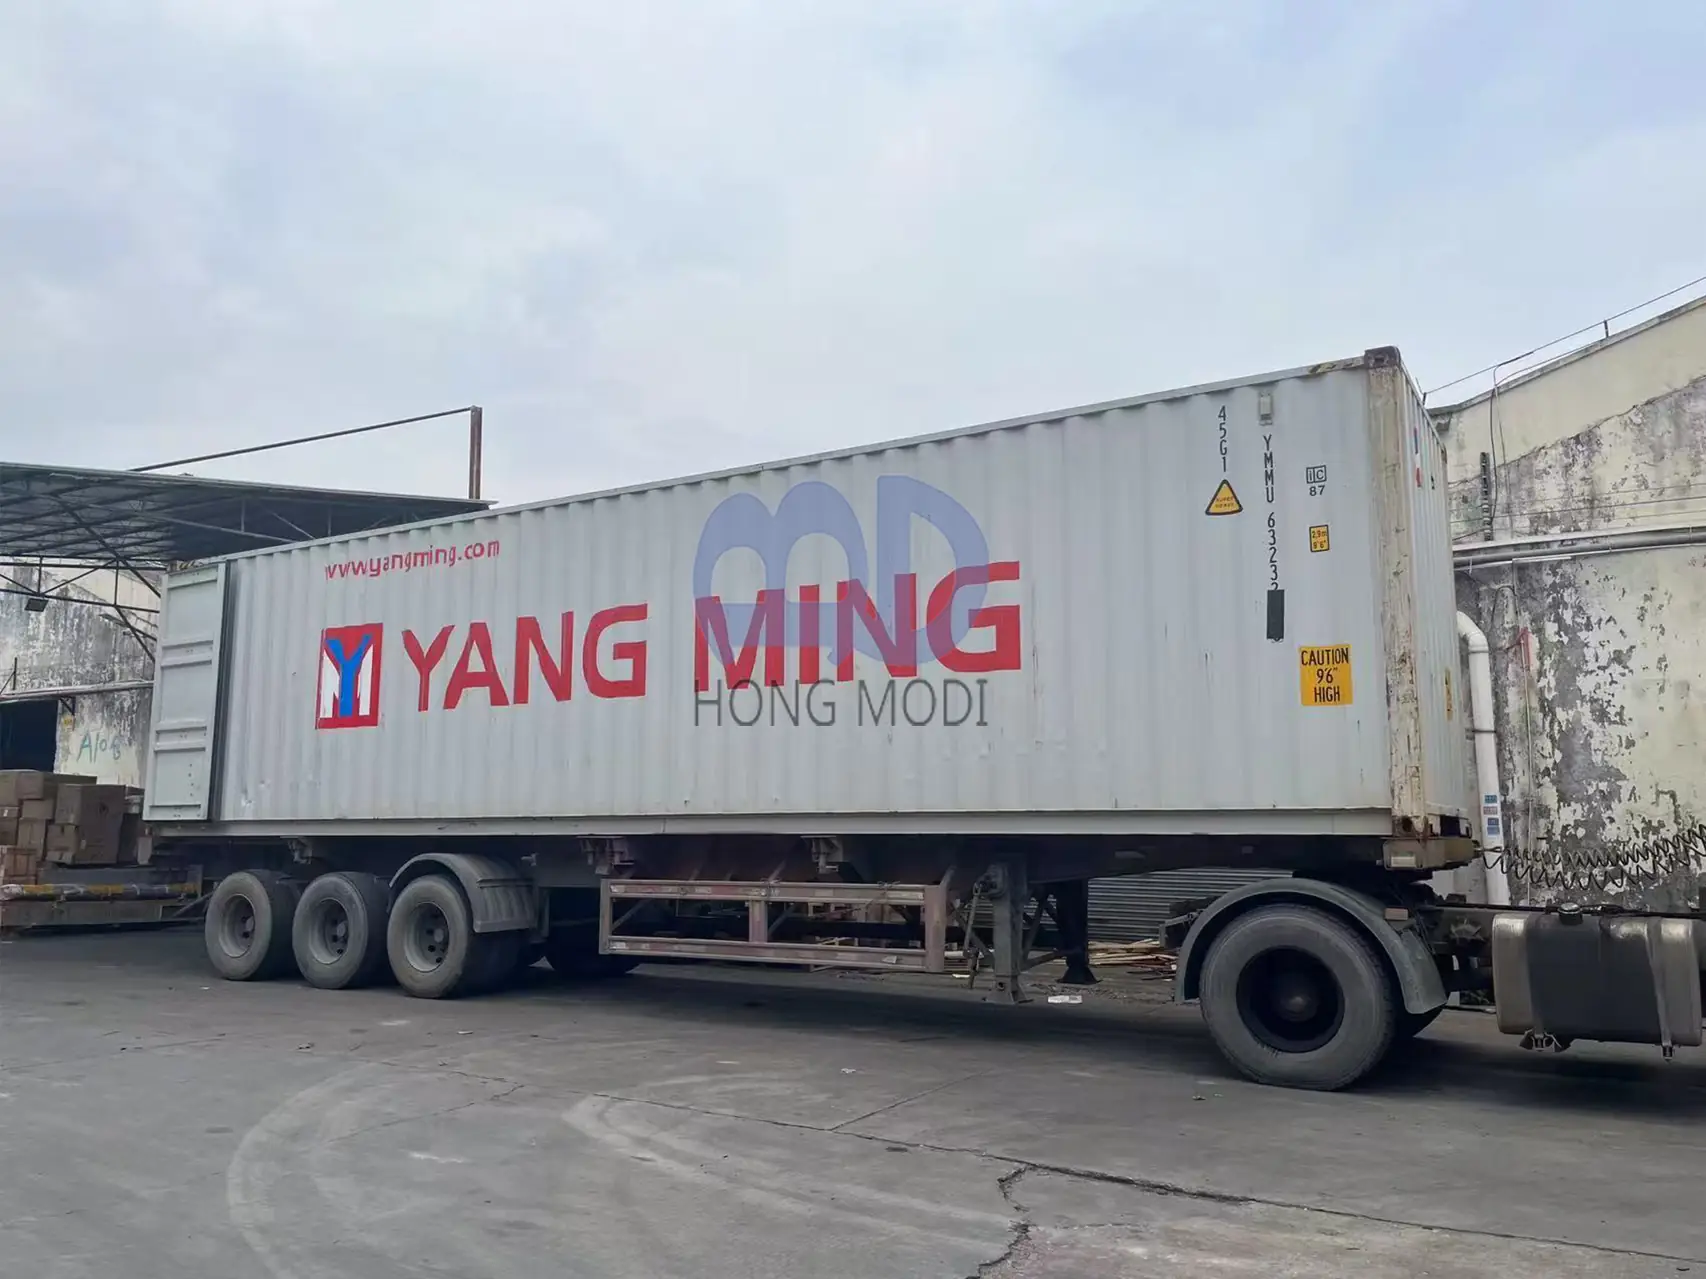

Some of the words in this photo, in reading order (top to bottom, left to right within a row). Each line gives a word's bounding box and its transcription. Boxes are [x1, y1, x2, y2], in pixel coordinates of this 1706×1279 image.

[1218, 405, 1228, 472] 45G1
[1263, 434, 1274, 503] YMMU
[1309, 485, 1325, 496] 87
[401, 604, 648, 712] YANG
[695, 560, 1021, 693] MING
[1301, 648, 1349, 666] CAUTION
[1314, 685, 1341, 703] HIGH
